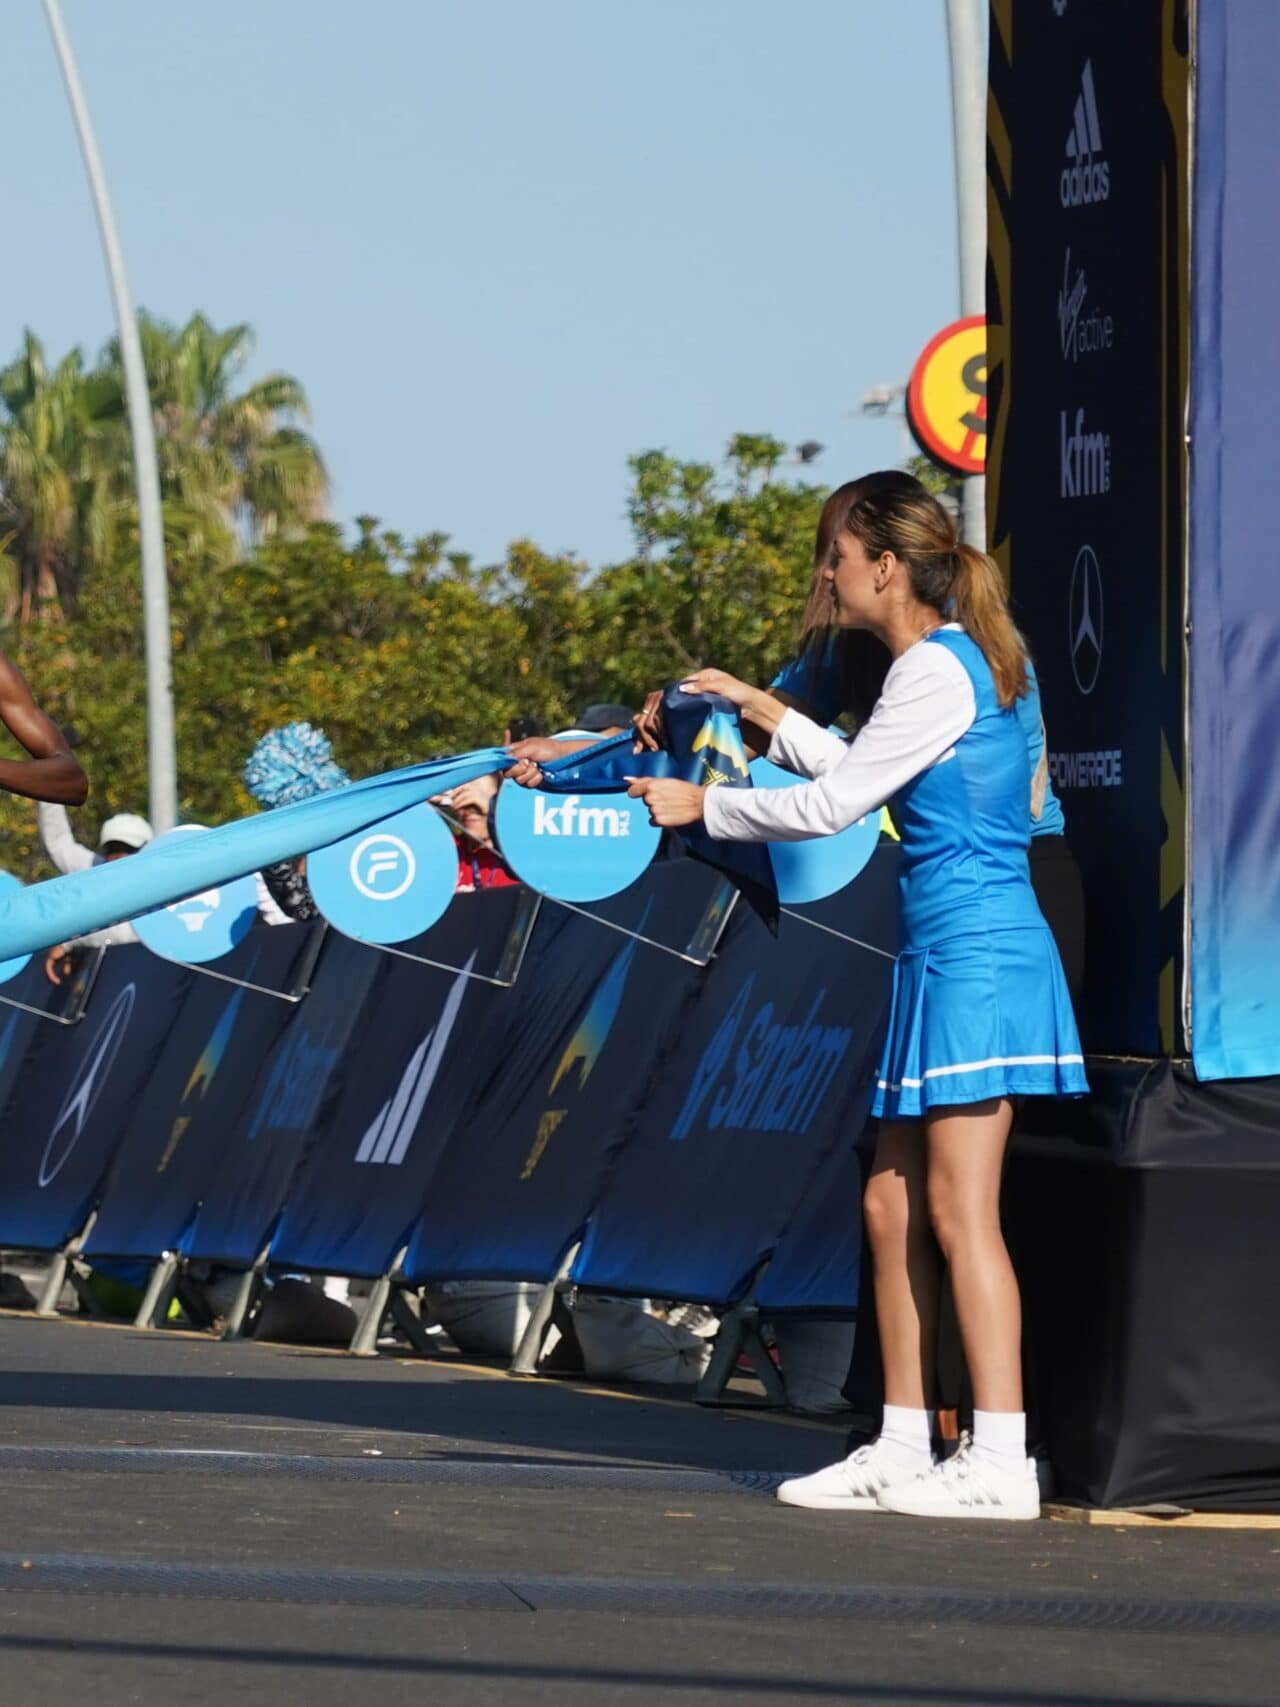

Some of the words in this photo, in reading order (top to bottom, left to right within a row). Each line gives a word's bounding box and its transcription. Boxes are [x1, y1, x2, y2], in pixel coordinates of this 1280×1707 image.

[1061, 152, 1109, 208] adidas
[1079, 307, 1112, 352] active
[1061, 408, 1104, 498] kfm
[1048, 749, 1122, 788] POWERADE
[534, 795, 620, 837] kfm
[708, 987, 853, 1134] Sanlam
